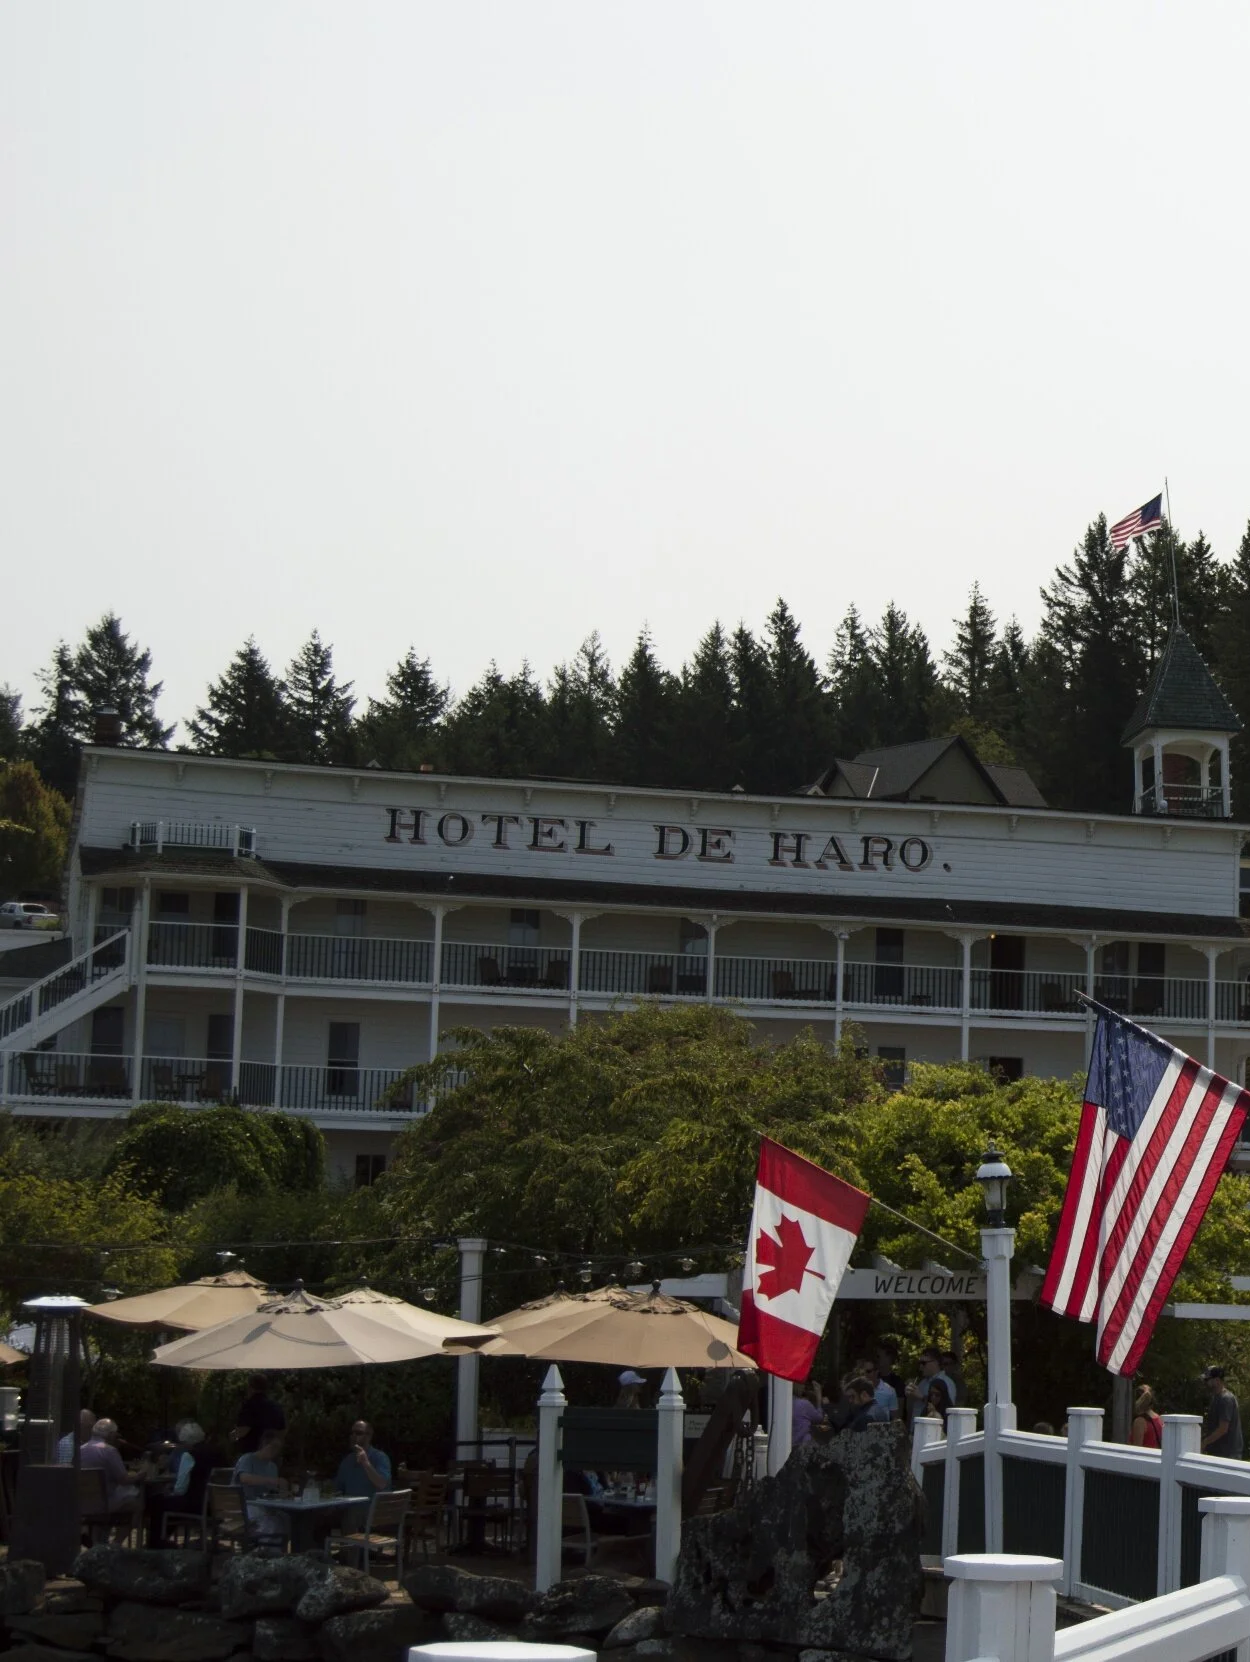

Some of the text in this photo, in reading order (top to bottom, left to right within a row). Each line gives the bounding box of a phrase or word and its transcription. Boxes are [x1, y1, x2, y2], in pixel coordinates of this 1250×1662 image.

[384, 807, 952, 873] HOTEL DE HARO.
[875, 1275, 979, 1295] WELCOME
